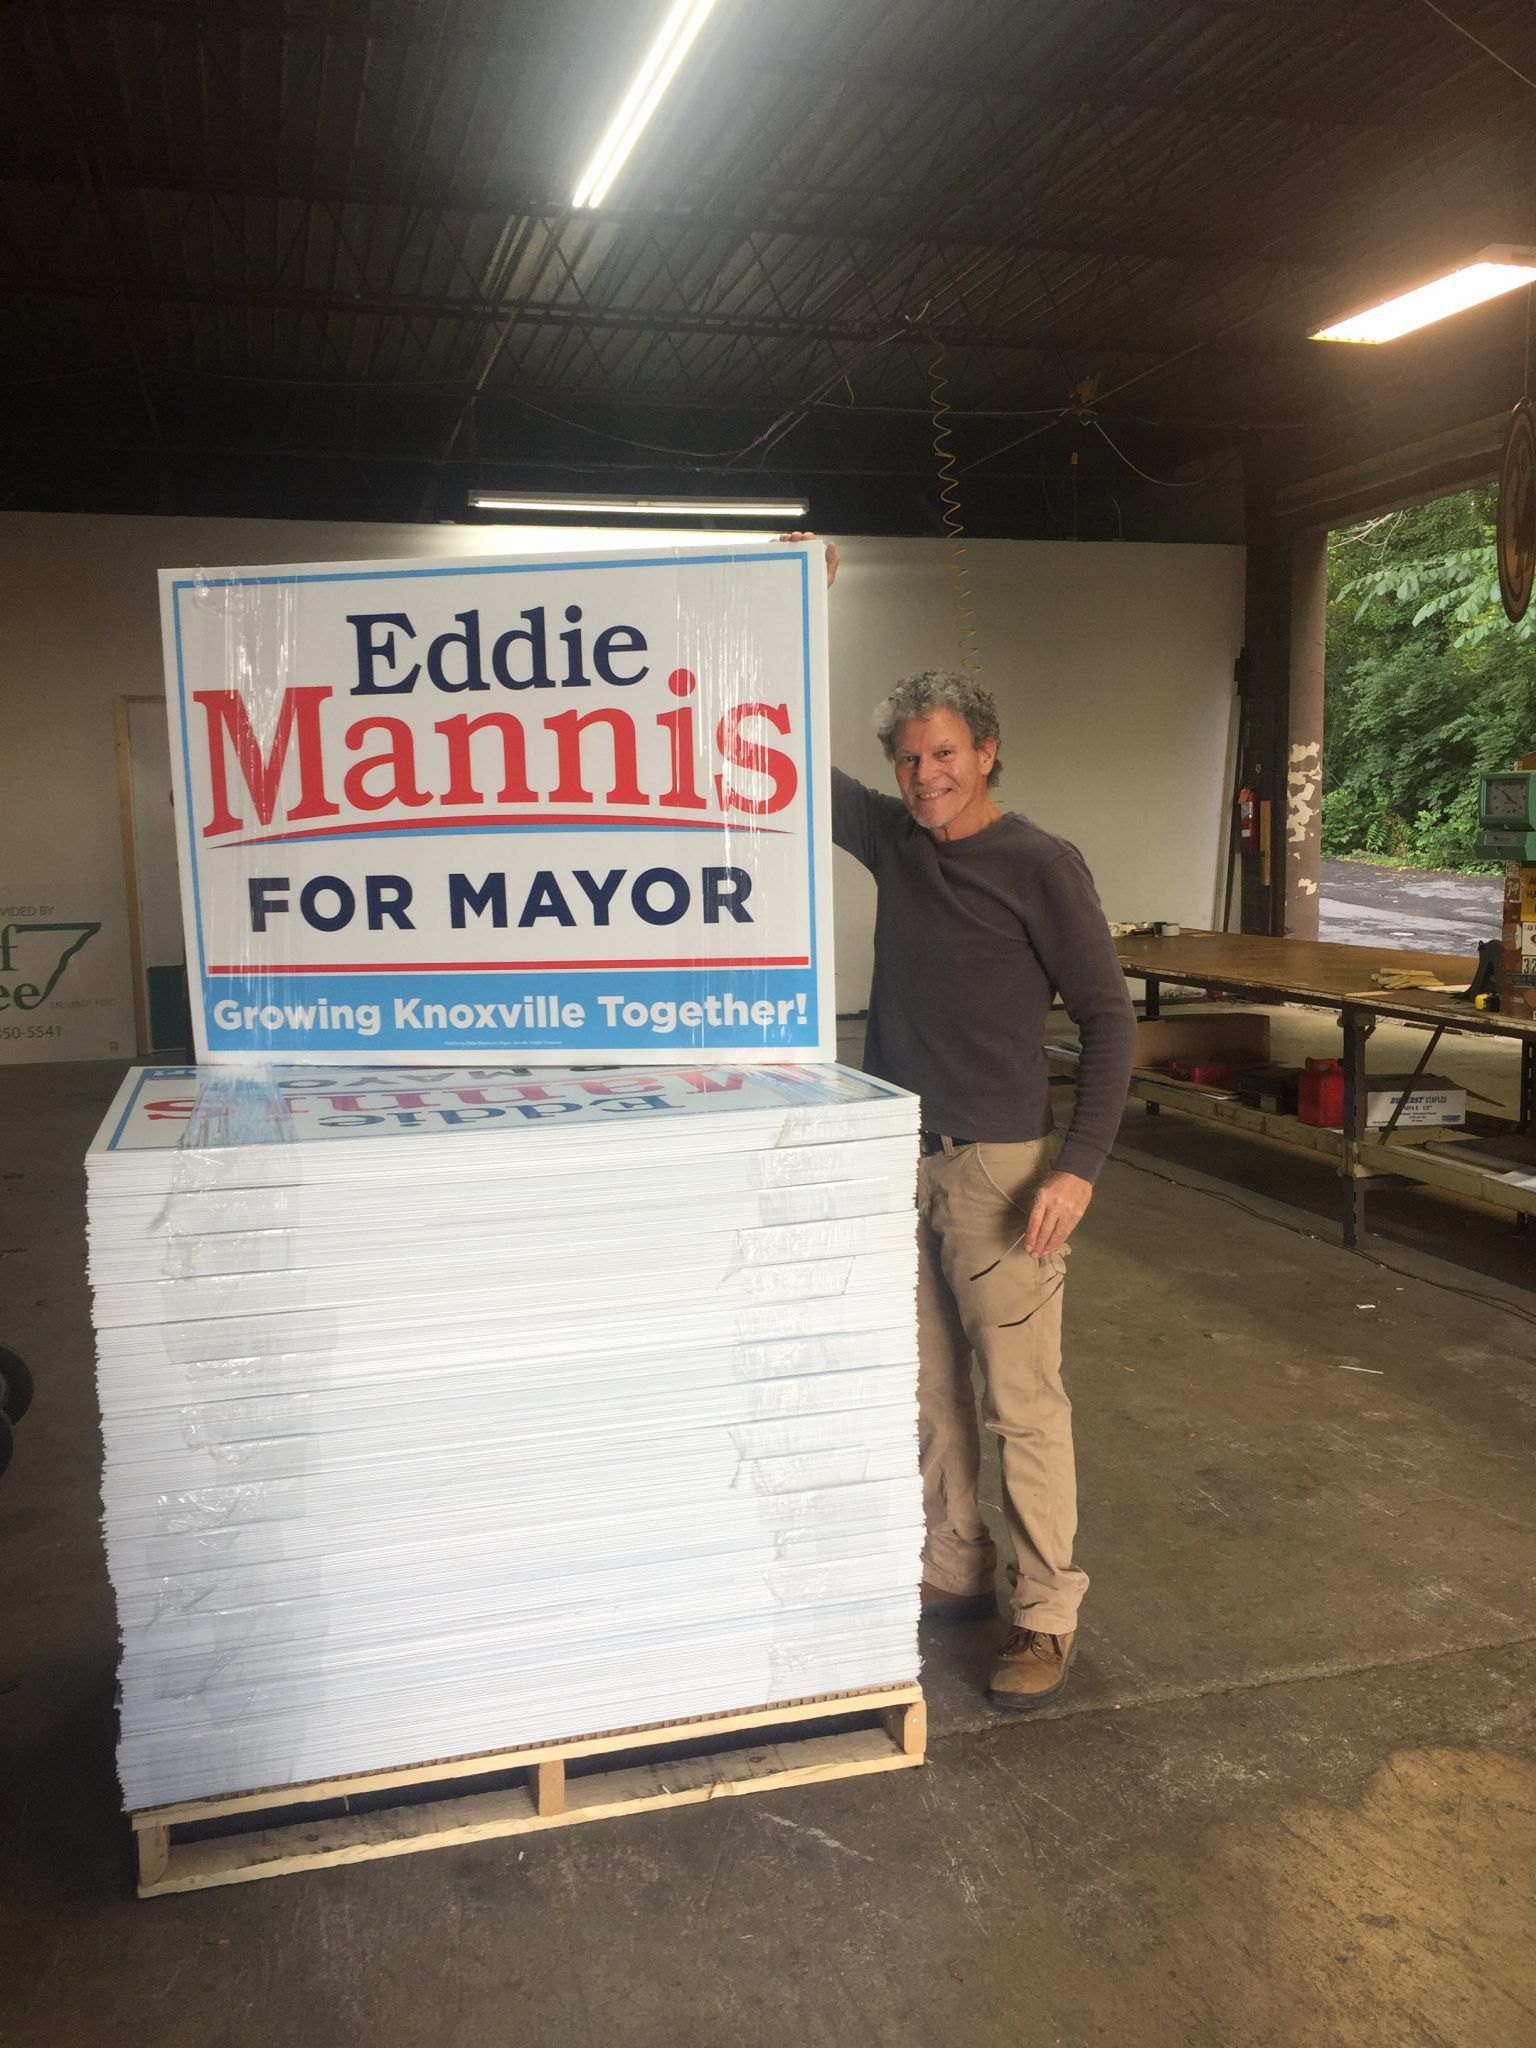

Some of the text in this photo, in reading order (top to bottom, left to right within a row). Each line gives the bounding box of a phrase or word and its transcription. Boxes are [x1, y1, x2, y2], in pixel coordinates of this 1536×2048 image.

[346, 604, 650, 697] Eddie
[193, 668, 799, 838] Mannis
[39, 905, 54, 916] BY
[248, 866, 754, 933] FOR MAYOR
[213, 990, 808, 1038] Growing Knoxville Together!
[276, 1066, 534, 1090] MAYO
[318, 1093, 686, 1128] Eddie
